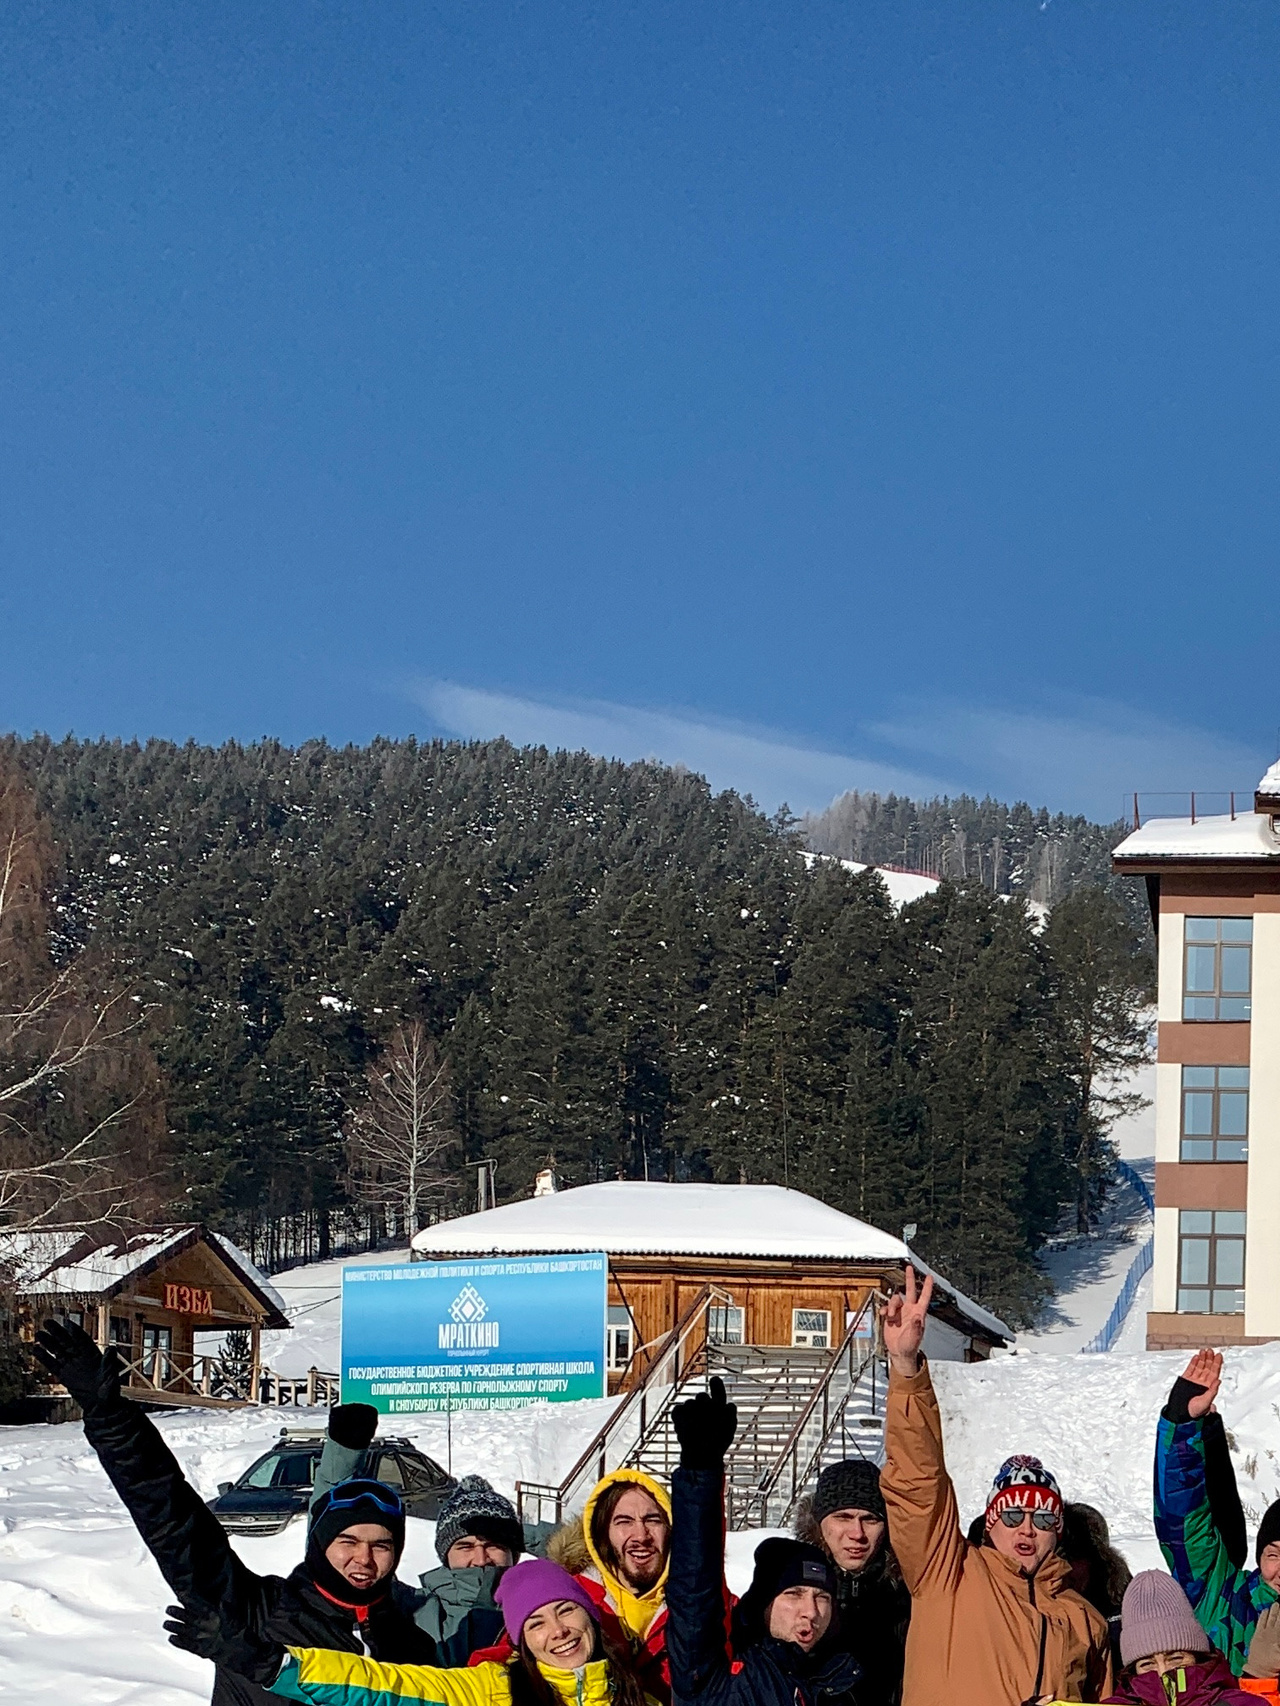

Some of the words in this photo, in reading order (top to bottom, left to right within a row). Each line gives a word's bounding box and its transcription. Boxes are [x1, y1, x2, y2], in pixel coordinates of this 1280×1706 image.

[481, 1264, 505, 1276] СПОРТА
[506, 1262, 549, 1275] РЕСПУБЛИКИ
[550, 1259, 602, 1273] БАШКОРТОСТАН
[164, 1283, 213, 1315] ИЗБА
[438, 1321, 499, 1349] МРАТКИНО
[349, 1366, 415, 1380] ГОСУДАРСТВЕННОЕ
[417, 1365, 463, 1378] БЮДЖЕТНОЕ
[464, 1363, 515, 1377] УЧРЕЖДЕНИЕ
[516, 1362, 564, 1376] СПОРТИВНАЯ
[566, 1361, 595, 1375] ШКОЛА
[371, 1381, 428, 1396] ОЛИМПИЙСКОГО
[429, 1381, 460, 1394] РЕЗЕРВА
[461, 1381, 472, 1393] ПО
[473, 1380, 537, 1393] ГОРНОЛЫЖНОМУ
[538, 1379, 568, 1392] СПОРТУ
[389, 1399, 395, 1412] И
[395, 1398, 439, 1412] СНОУБОРДУ
